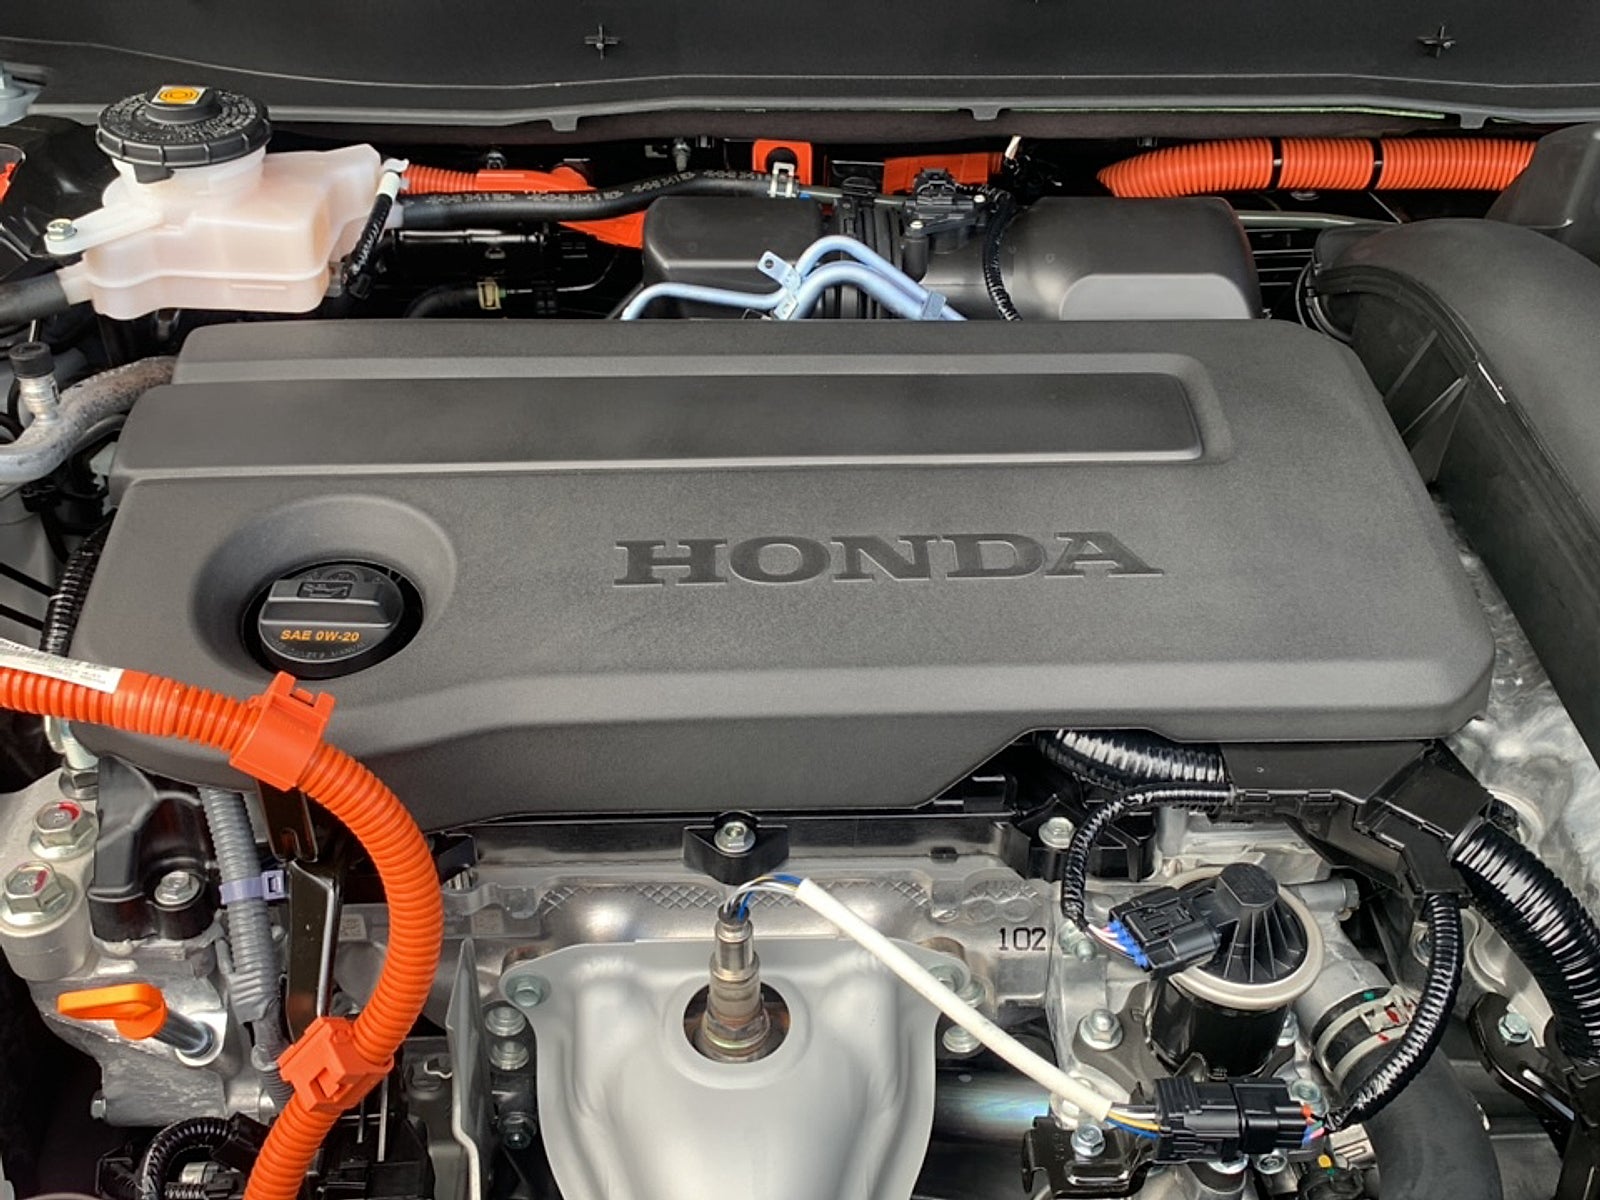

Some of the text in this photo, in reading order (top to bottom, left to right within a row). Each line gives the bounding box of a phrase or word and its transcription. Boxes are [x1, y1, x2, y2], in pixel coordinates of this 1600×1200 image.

[612, 531, 1164, 588] HONDA
[281, 629, 360, 642] SAE 0W-20
[999, 927, 1047, 951] 102
